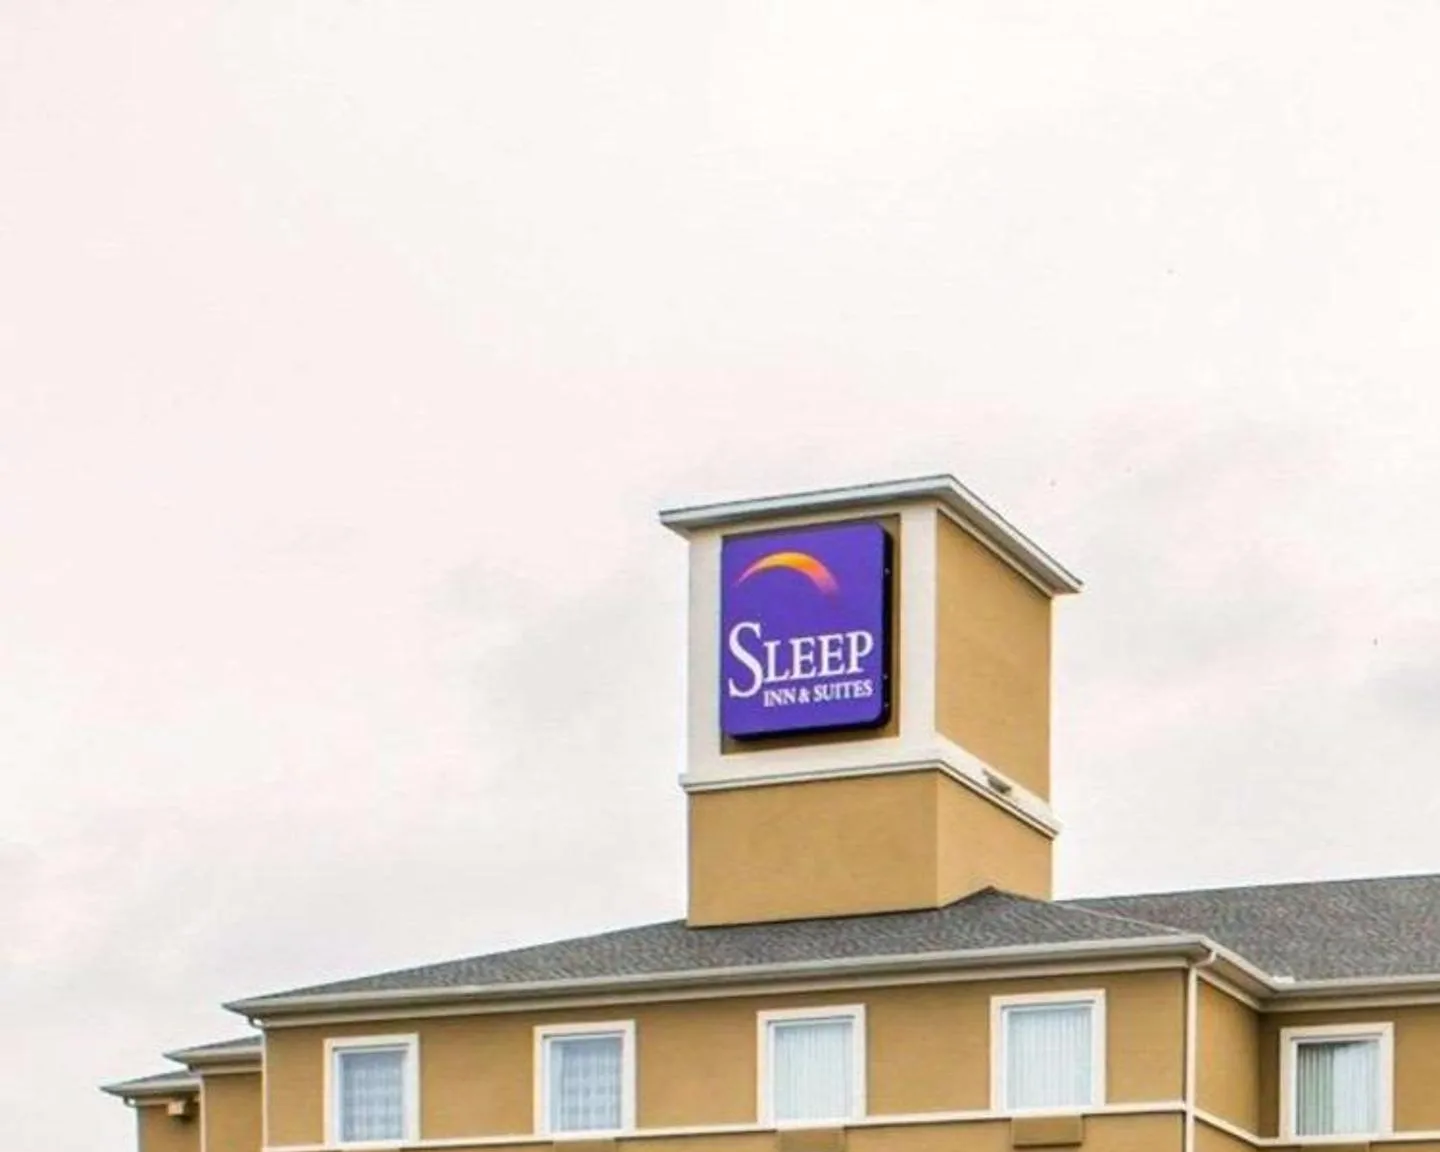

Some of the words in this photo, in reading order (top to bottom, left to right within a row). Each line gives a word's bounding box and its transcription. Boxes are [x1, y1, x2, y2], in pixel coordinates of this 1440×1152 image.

[728, 621, 874, 698] SLEEP
[763, 687, 796, 707] INN
[797, 687, 811, 704] &
[813, 679, 874, 702] SUITES
